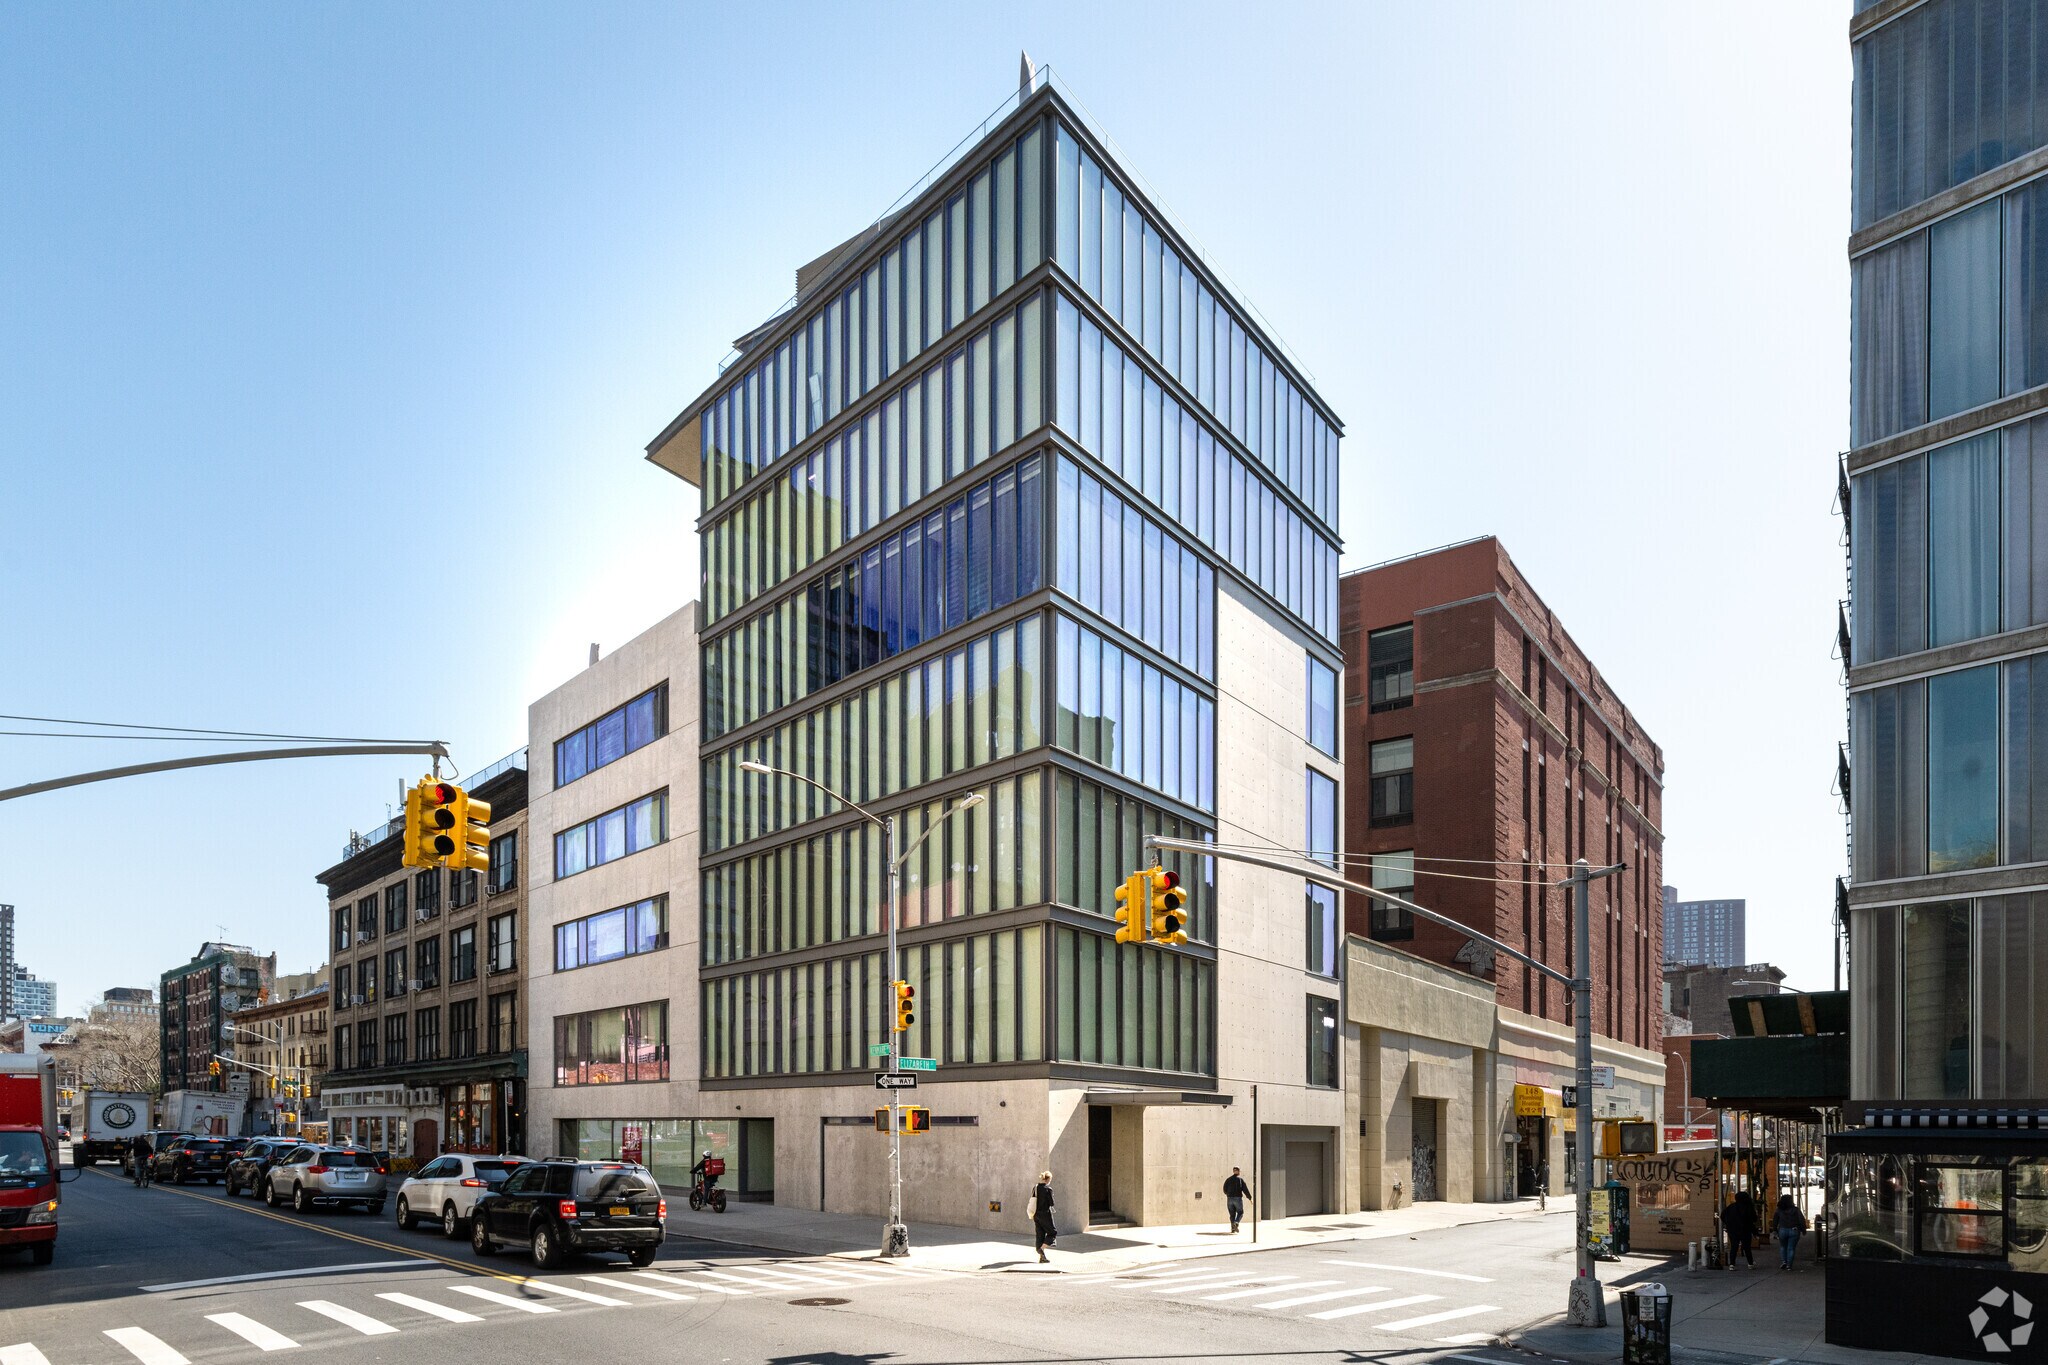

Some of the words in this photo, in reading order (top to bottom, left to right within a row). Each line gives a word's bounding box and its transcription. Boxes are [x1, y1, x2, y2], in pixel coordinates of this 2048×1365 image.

[899, 1059, 930, 1069] ELIZABETH
[881, 1077, 894, 1085] ONE
[1525, 1087, 1539, 1095] 148
